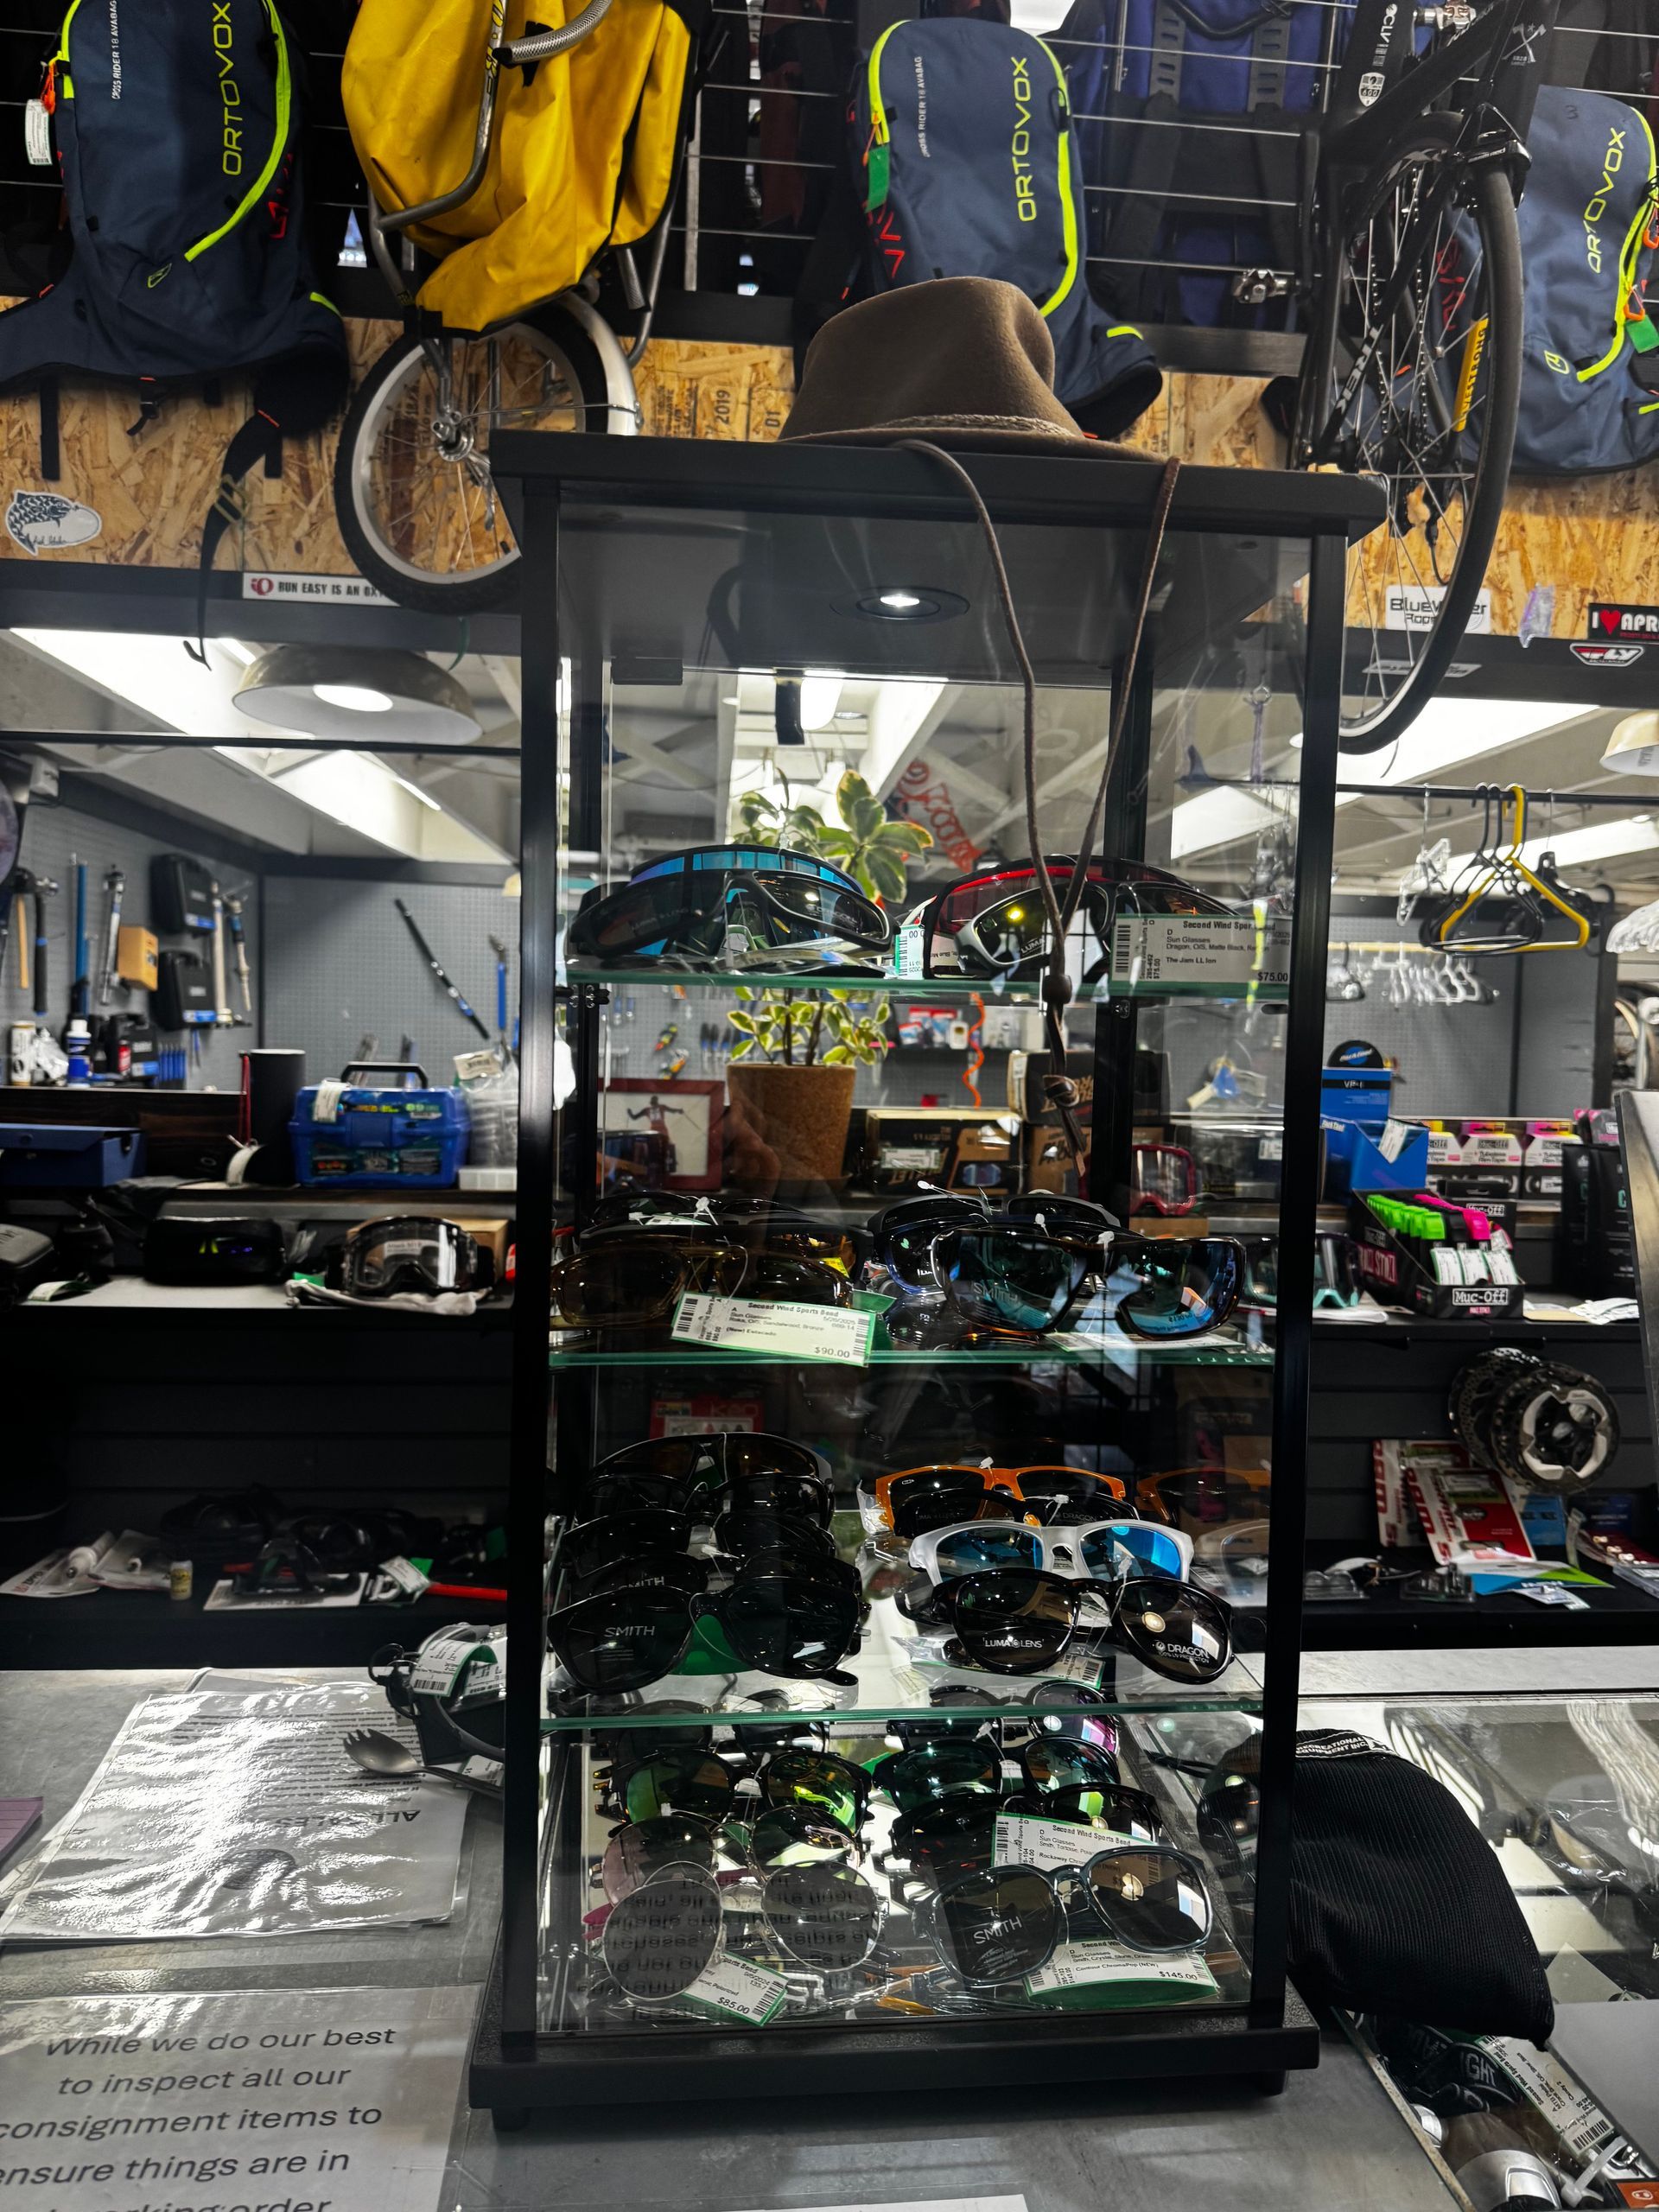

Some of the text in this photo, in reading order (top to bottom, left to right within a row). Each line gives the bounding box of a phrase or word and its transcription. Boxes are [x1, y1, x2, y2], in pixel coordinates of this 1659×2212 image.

[111, 38, 119, 48] 18
[112, 51, 122, 79] RIDER
[914, 56, 925, 88] AVABAG
[213, 2, 243, 176] ORTOVOX
[1011, 56, 1037, 222] ORTOVOX
[1583, 127, 1626, 274] ORTOVOX
[715, 390, 731, 425] 2019
[278, 582, 360, 596] RUN EASY IS AN
[1183, 921, 1232, 930] Second Wind
[1257, 972, 1288, 982] $75.00
[1454, 1291, 1506, 1303] Muc-Off
[747, 1302, 774, 1311] Second
[797, 1306, 819, 1315] Sports
[820, 1309, 839, 1318] Bend
[815, 1346, 850, 1359] $90.00
[604, 1625, 655, 1637] SMITH
[985, 1639, 1011, 1648] LUMA
[1166, 1643, 1210, 1659] DRAGON
[1296, 1744, 1351, 1755] EQUIPMENT
[1052, 1824, 1131, 1847] Second Wind Sports Bend
[1052, 1837, 1076, 1847] Glasses
[1039, 1853, 1067, 1863] Rockaway
[973, 1916, 1022, 1944] SMITH
[1159, 1970, 1198, 1981] $145.00
[717, 1997, 750, 2014] $85.00
[47, 2028, 397, 2056] While we do our best
[1504, 2060, 1517, 2075] Sports
[58, 2068, 352, 2096] to inspect all our
[1515, 2074, 1528, 2088] Wind
[1526, 2086, 1544, 2106] Second
[1560, 2084, 1574, 2101] Candy
[0, 2106, 382, 2141] consignment items to
[0, 2150, 350, 2186] ensure things are in
